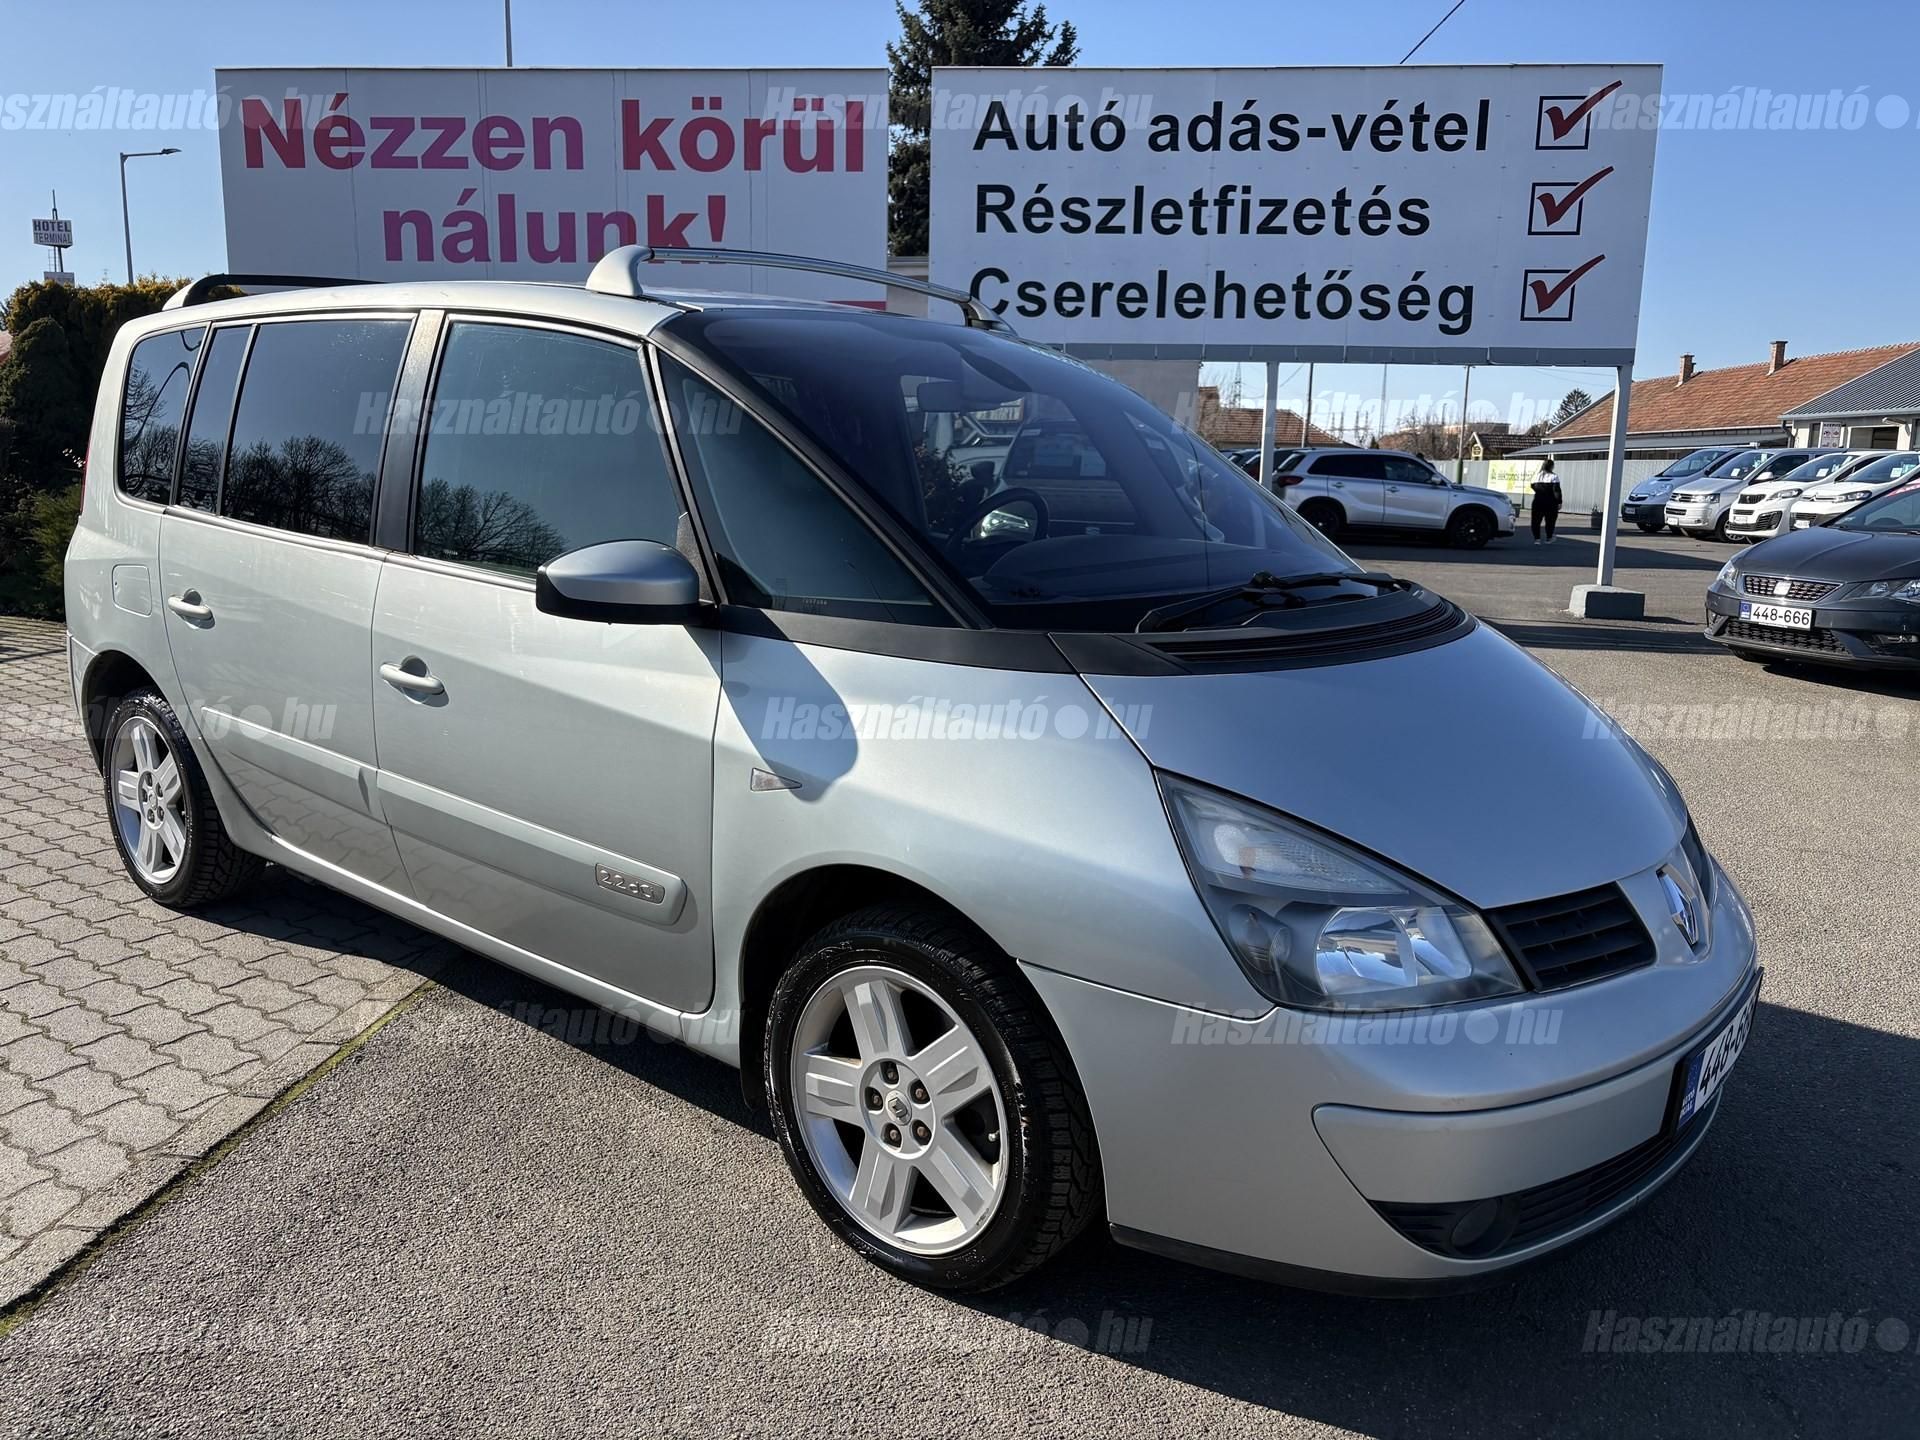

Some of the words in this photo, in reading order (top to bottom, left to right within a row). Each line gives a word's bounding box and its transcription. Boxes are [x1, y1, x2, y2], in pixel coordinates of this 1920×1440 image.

[241, 92, 584, 170] Nézzen
[621, 96, 865, 173] körül
[972, 100, 1126, 152] Autó
[1148, 99, 1490, 152] adás-vétel
[33, 220, 71, 232] HOTEL
[383, 188, 727, 264] nálunk!
[976, 183, 1430, 236] Részletfizetés
[33, 232, 73, 243] TERMINAL
[970, 267, 1474, 336] Cserelehetőség
[1753, 606, 1810, 625] 448-666
[600, 869, 627, 890] 2.2
